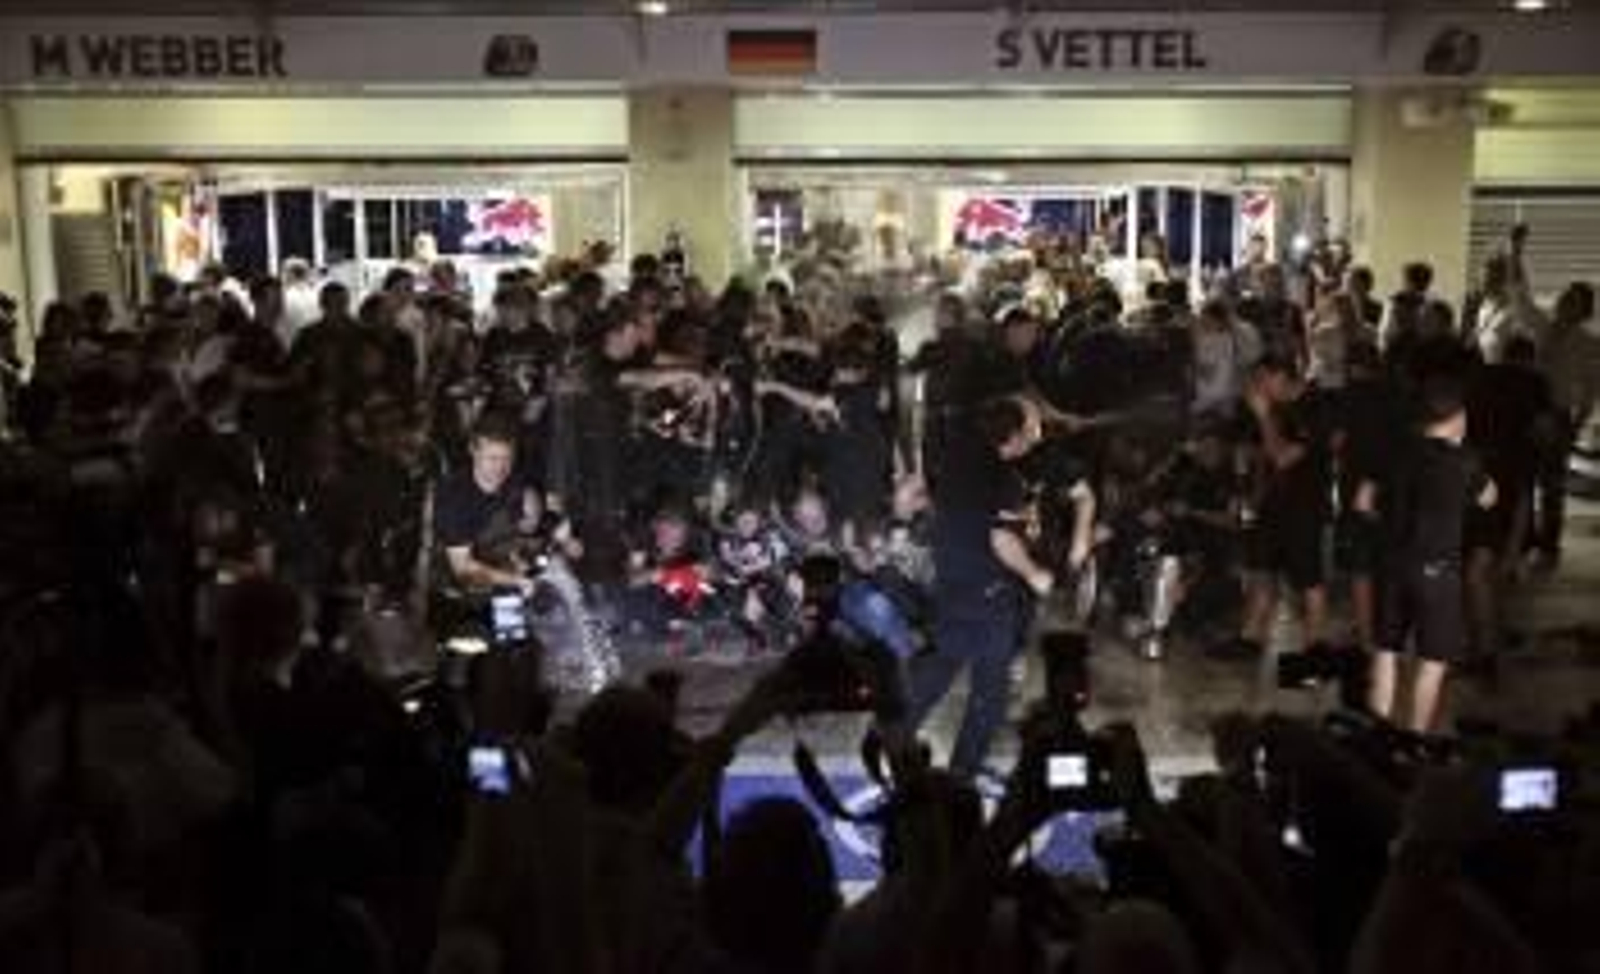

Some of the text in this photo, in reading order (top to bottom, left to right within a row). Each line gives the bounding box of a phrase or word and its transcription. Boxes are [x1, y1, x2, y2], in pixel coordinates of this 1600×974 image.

[30, 35, 286, 78] M WEBBER
[996, 28, 1206, 69] S VETTEL
